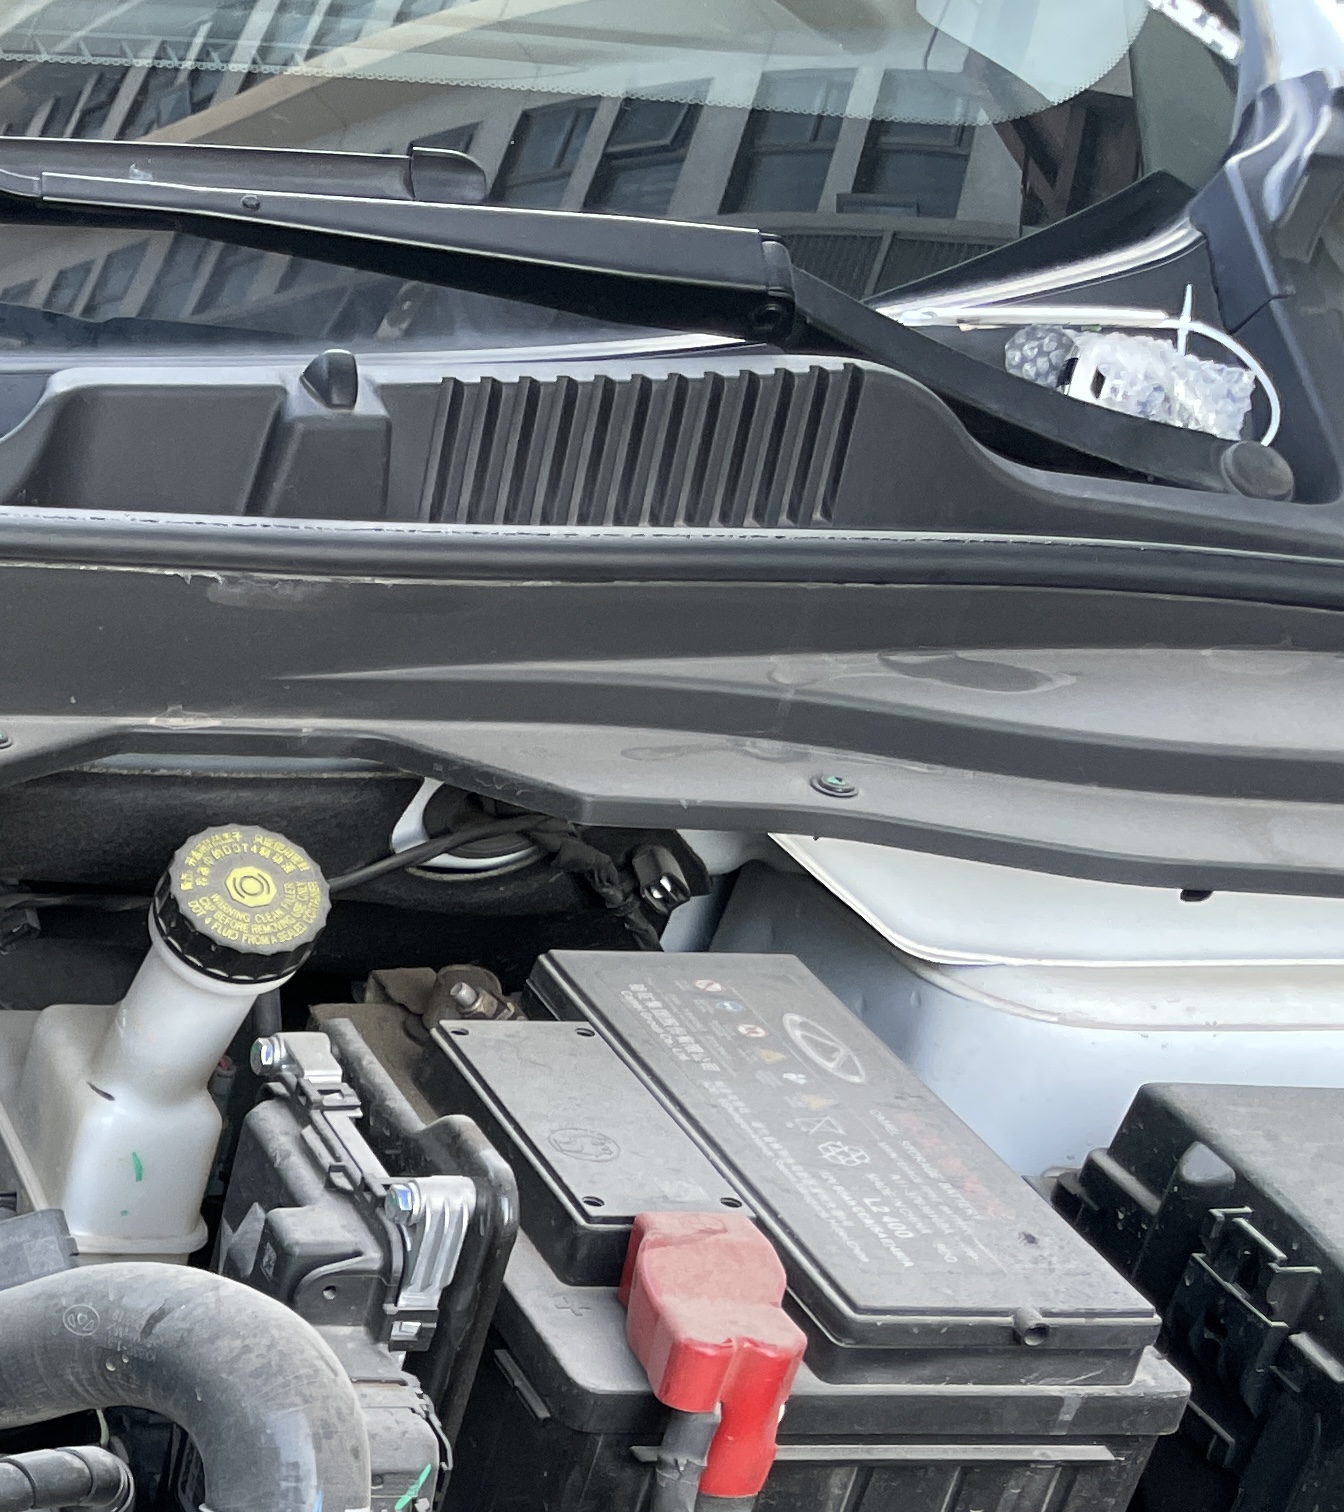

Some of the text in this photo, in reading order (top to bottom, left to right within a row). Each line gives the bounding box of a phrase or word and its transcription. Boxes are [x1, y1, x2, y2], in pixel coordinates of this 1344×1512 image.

[188, 899, 207, 917] DOT
[211, 922, 239, 940] FLUID
[241, 933, 270, 945] FROM
[276, 921, 307, 943] SEALED
[198, 896, 216, 911] CAP
[213, 910, 249, 933] BEFORE
[251, 914, 296, 935] REMOVING
[211, 882, 296, 923] WARNING CLEAN FILLER
[898, 1140, 947, 1181] STORAGE
[937, 1182, 986, 1220] BATTERY
[862, 1198, 914, 1238] L2 400
